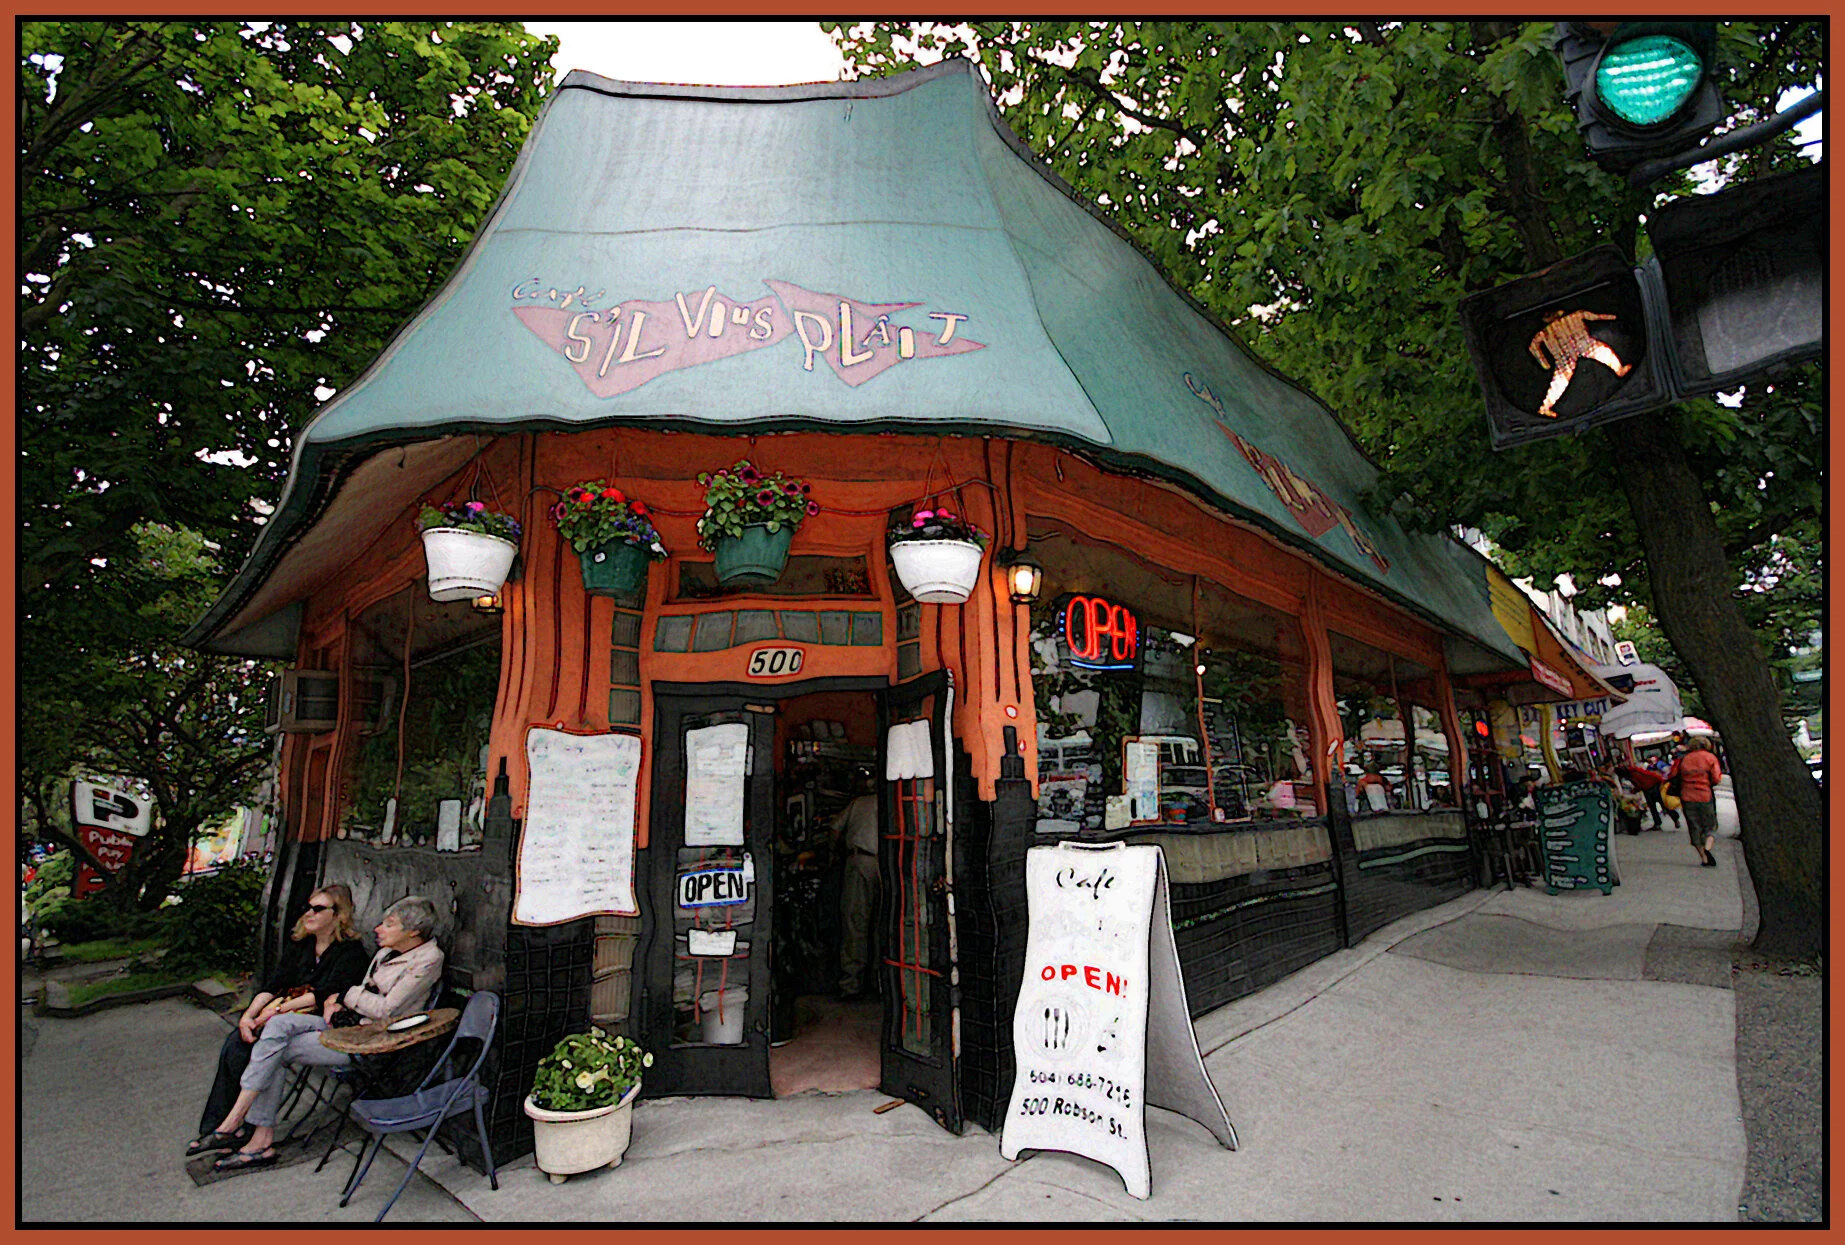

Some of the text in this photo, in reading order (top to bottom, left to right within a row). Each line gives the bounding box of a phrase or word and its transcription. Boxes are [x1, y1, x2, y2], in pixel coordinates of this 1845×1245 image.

[1065, 595, 1137, 660] OPEN
[751, 650, 802, 674] 500
[1556, 703, 1578, 719] KEY
[685, 872, 744, 903] OPEN
[1041, 964, 1127, 998] OPEN!
[1020, 1097, 1049, 1116] 500
[1053, 1097, 1104, 1128] Robson
